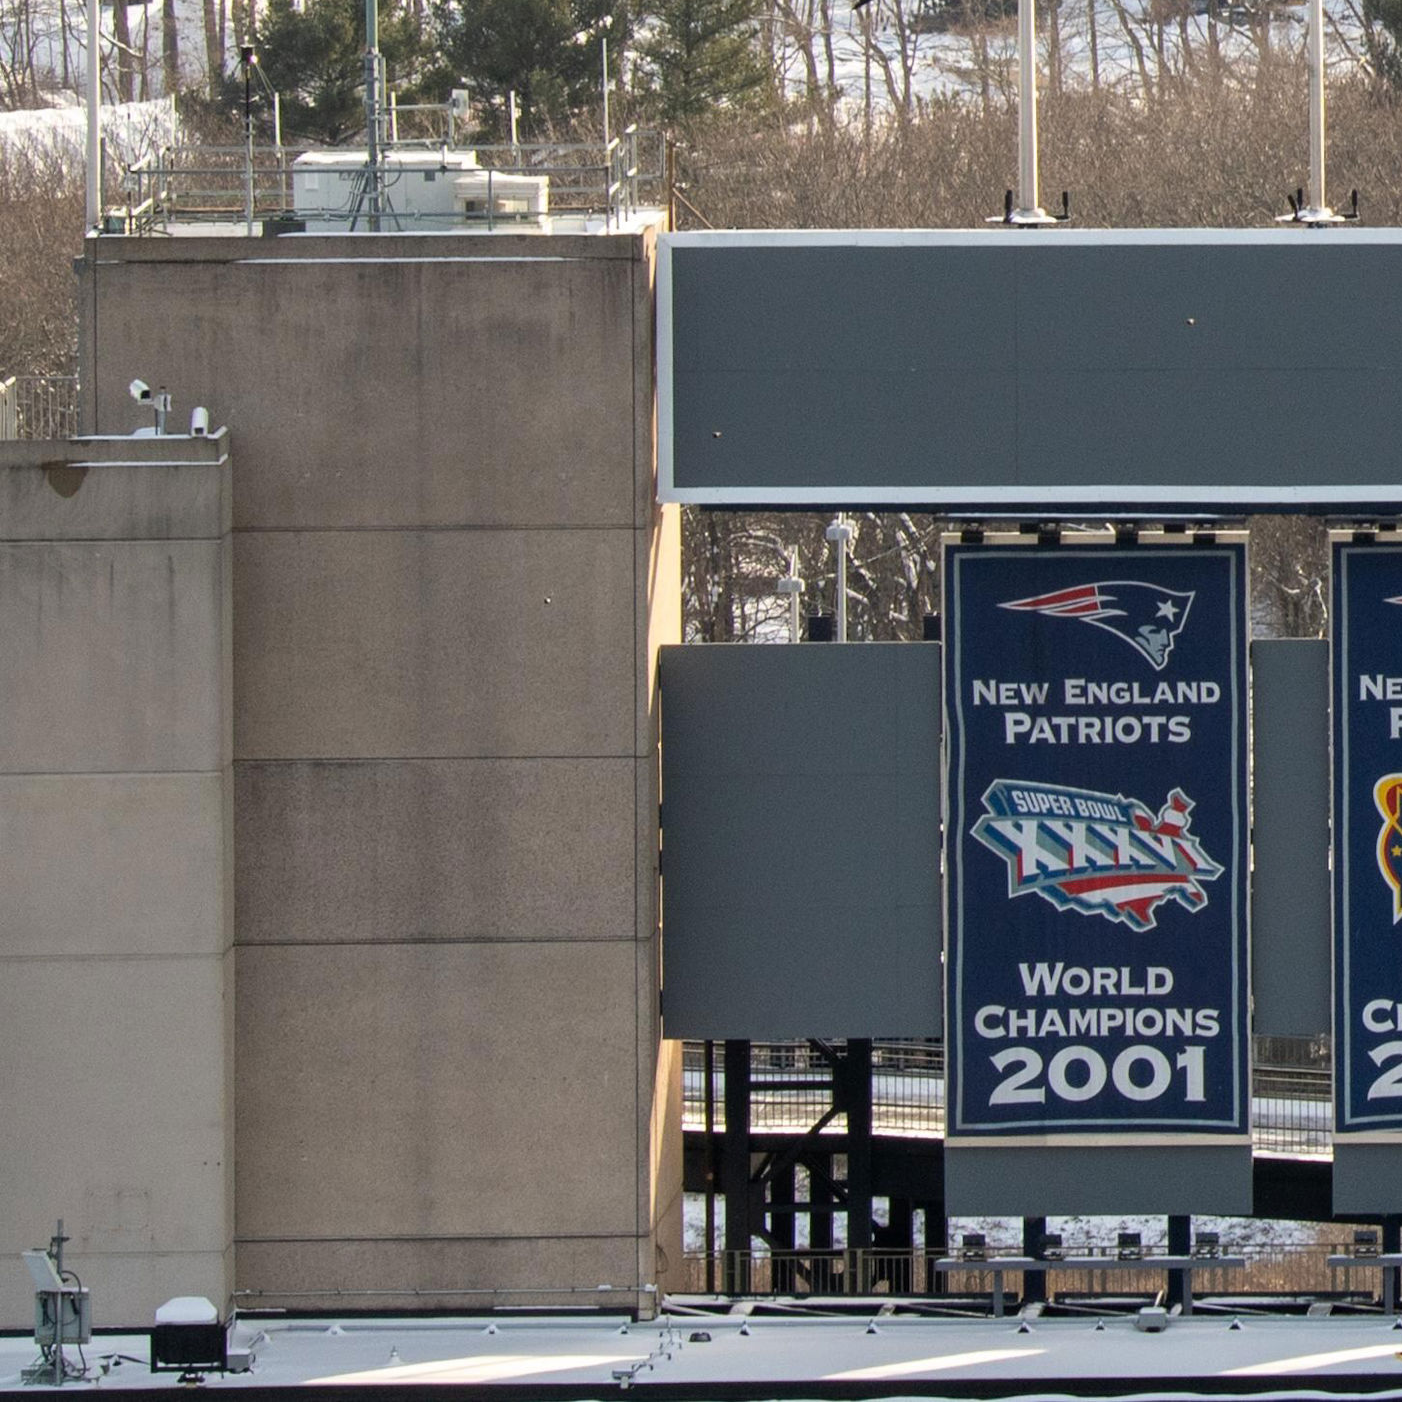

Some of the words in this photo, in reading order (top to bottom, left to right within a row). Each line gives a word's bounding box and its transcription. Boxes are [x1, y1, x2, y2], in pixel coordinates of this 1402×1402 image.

[972, 679, 1049, 706] NEW
[1064, 678, 1221, 705] ENGLAND
[1004, 712, 1192, 744] PATRIOTS
[1011, 790, 1072, 815] SUPER
[1074, 798, 1127, 822] BOWL
[985, 819, 1214, 884] XXXVI
[1018, 961, 1174, 996] WORLD
[974, 1004, 1220, 1039] CHAMPIONS
[988, 1044, 1206, 1106] 2001
